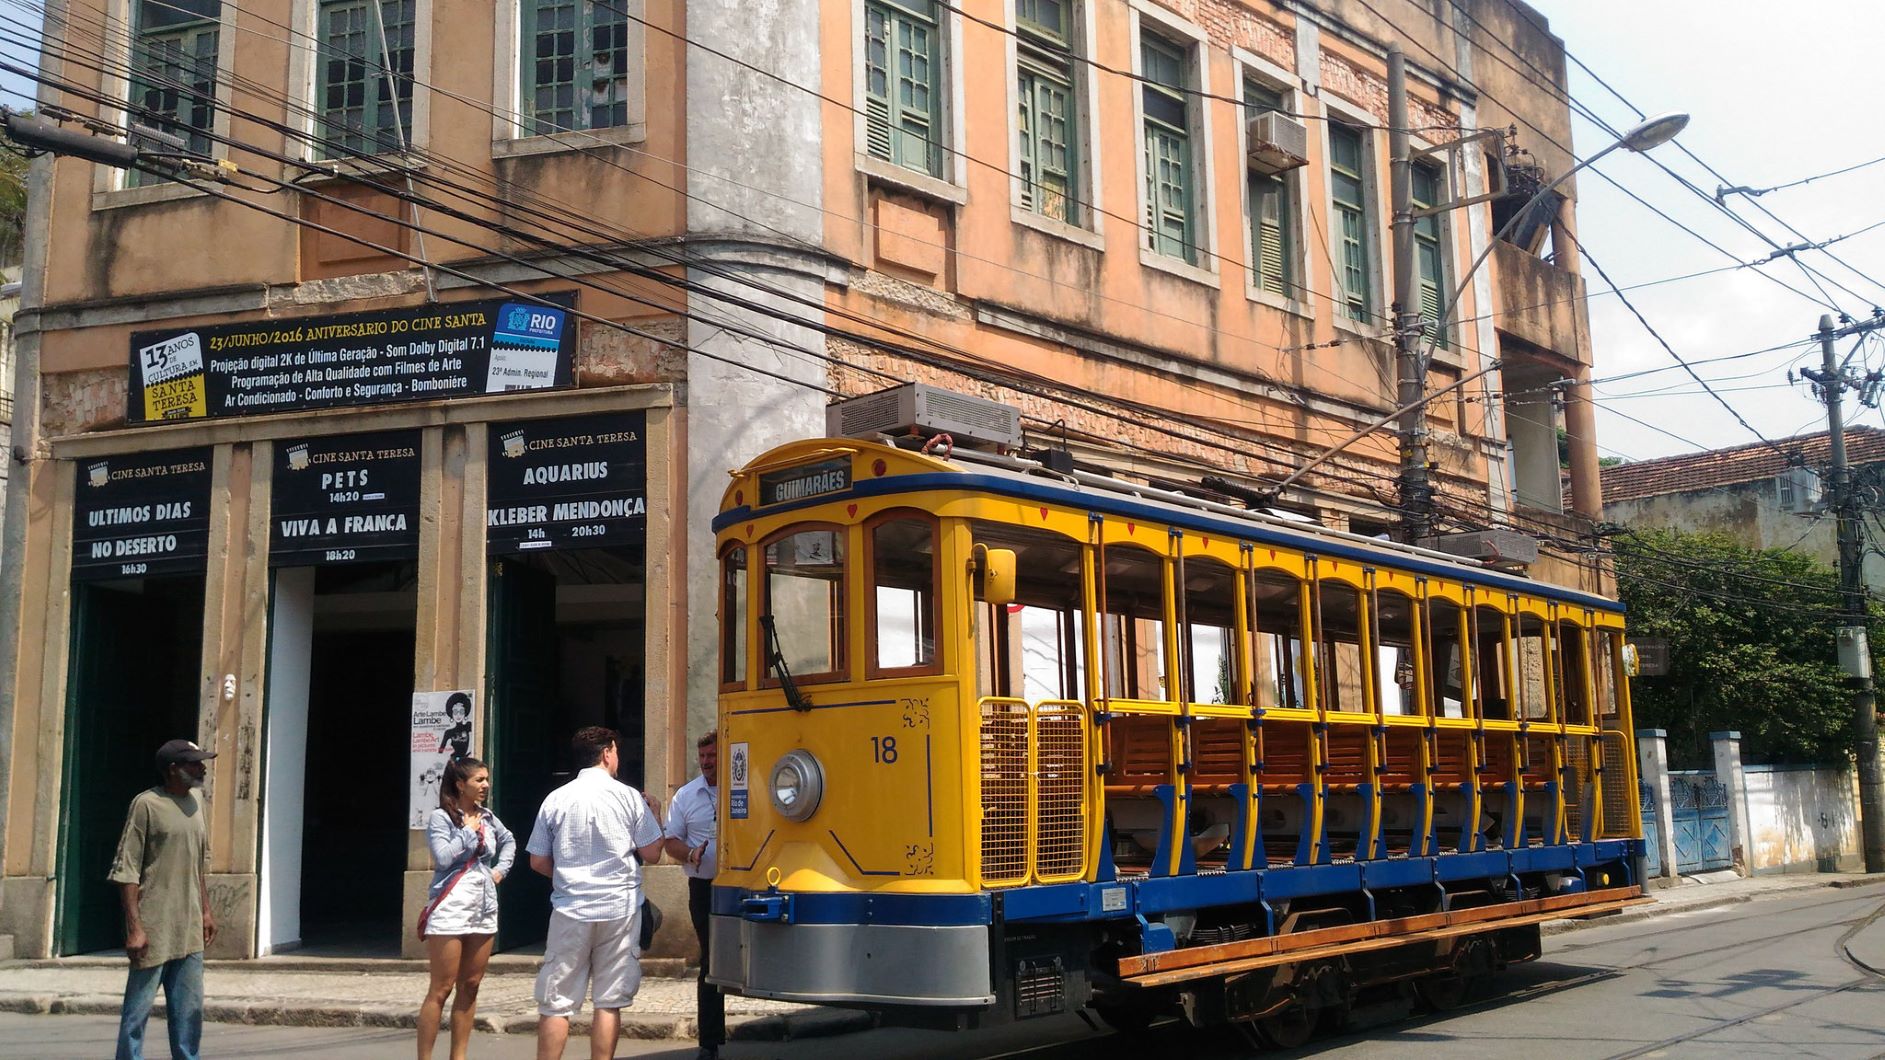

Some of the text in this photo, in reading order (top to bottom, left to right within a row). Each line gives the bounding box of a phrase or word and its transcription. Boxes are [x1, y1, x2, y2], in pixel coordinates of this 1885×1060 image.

[209, 312, 487, 351] 23/JUNHO/2016 ANIVERSARIO DO CINE SANTA
[530, 314, 556, 330] RIO
[146, 337, 194, 368] 13 ANOS
[210, 358, 248, 374] Projeção
[251, 354, 278, 371] digital
[280, 352, 293, 366] 2K
[294, 352, 306, 364] de
[308, 348, 337, 364] Última
[340, 346, 377, 362] Geração
[386, 344, 407, 358] Som
[410, 341, 436, 356] Dolby
[438, 337, 468, 354] Digital
[470, 336, 485, 349] 7.1
[148, 362, 188, 383] CULTURA
[232, 358, 462, 390] Programação de Alta Qualidade com Filmes de Arte
[504, 368, 522, 377] Admin.
[524, 368, 548, 379] Regional
[152, 380, 196, 398] SANTA
[224, 394, 236, 407] Ar
[238, 389, 296, 406] Condicionado
[305, 386, 342, 400] Conforto
[346, 386, 351, 396] e
[354, 382, 402, 398] Segurança
[412, 374, 468, 392] Bomboniére
[152, 392, 198, 411] TERESA
[529, 431, 638, 450] CINE SANTA TERESA
[313, 448, 416, 464] CINE SANTA TERESA
[112, 462, 206, 480] CINE SANTA TERESA
[322, 469, 368, 490] PETS
[523, 462, 608, 485] AQUARIUS
[776, 470, 844, 502] GUIMARÃES
[330, 492, 360, 503] 14h20
[88, 502, 192, 526] ULTIMOS DIAS
[488, 497, 645, 526] KLEBER MENDONÇA
[281, 514, 407, 538] VIVA A FRANÇA
[528, 524, 606, 539] 14h 20h30
[92, 535, 177, 558] NO DESERTO
[326, 550, 356, 561] 18h20
[122, 564, 147, 574] 16h30
[870, 736, 898, 764] 18
